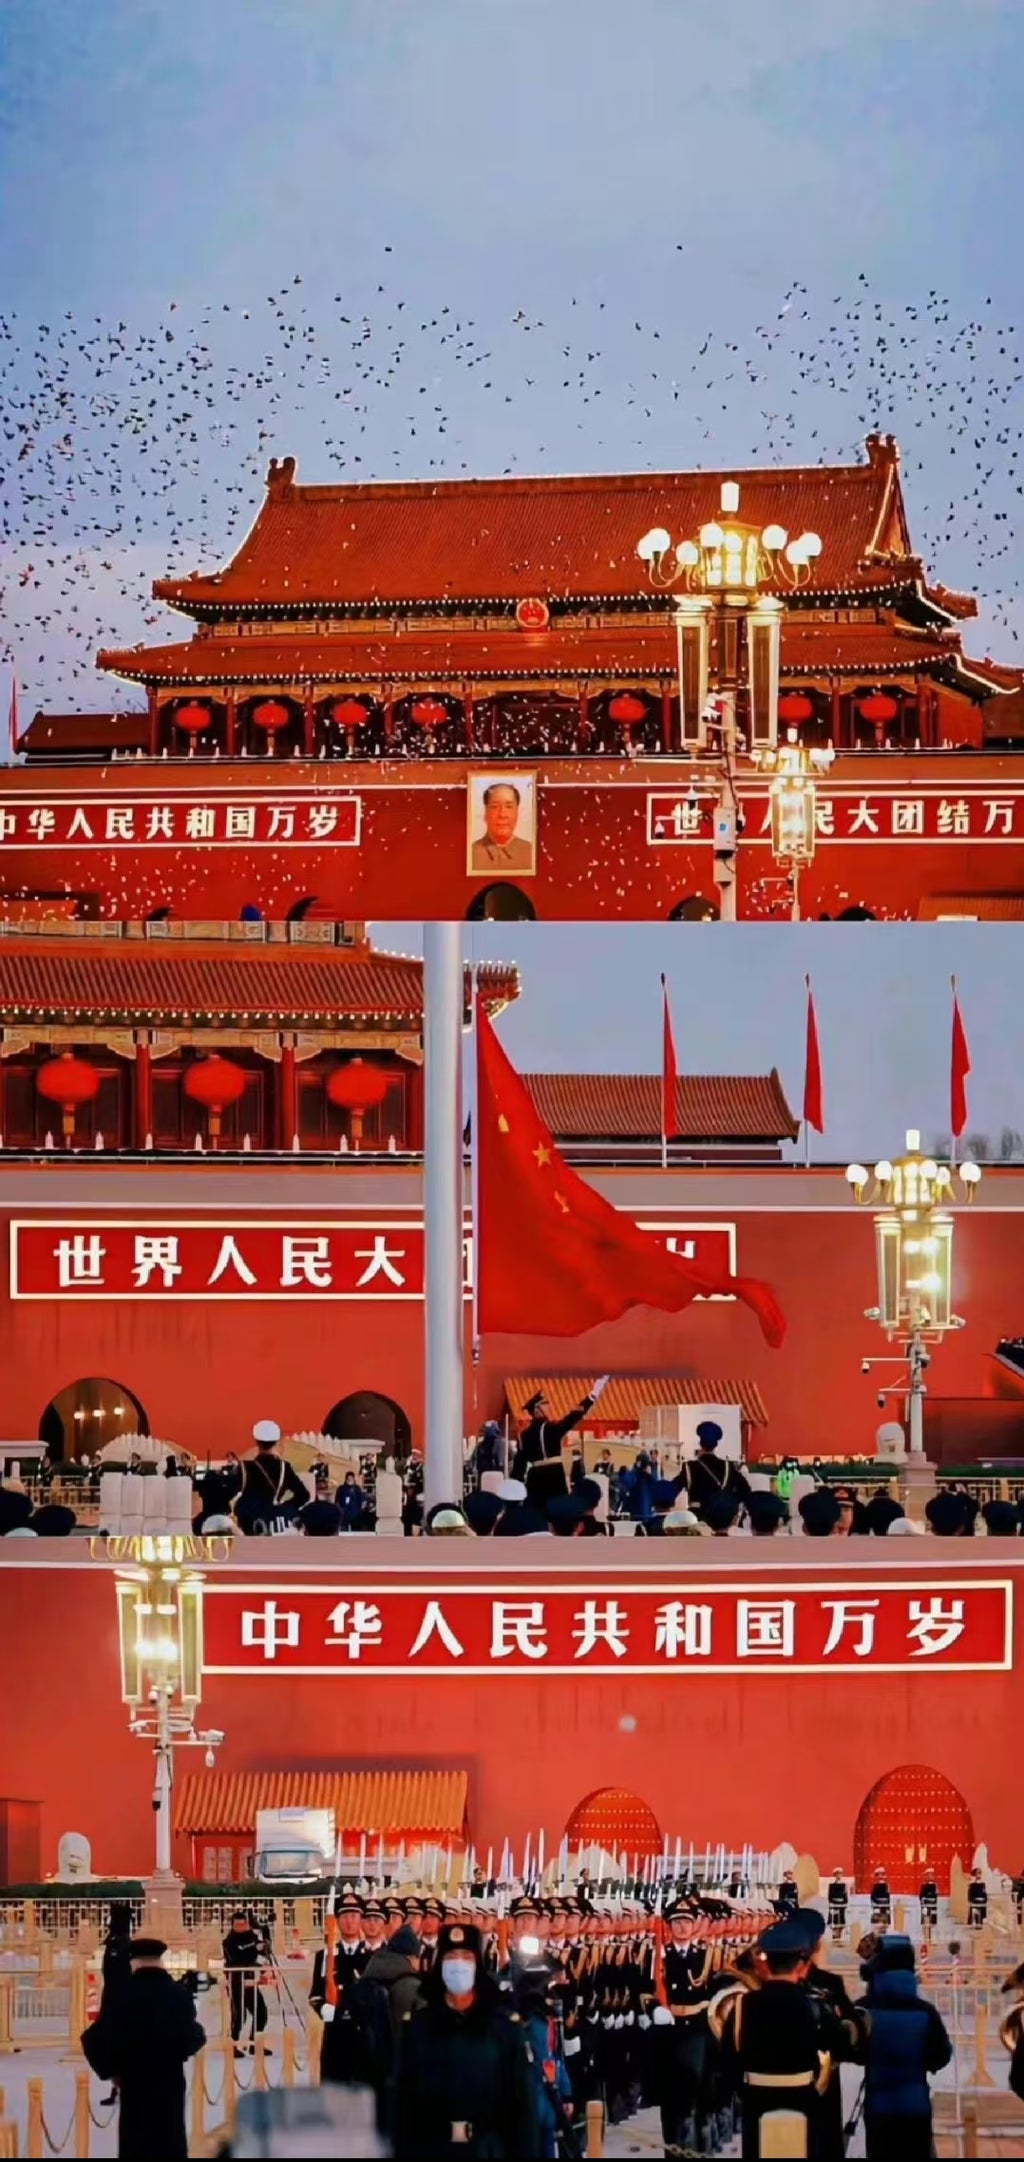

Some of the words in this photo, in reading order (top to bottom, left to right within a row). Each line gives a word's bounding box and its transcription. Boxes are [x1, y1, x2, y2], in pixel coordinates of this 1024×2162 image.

[0, 804, 338, 841] 中华人民共和国万岁
[670, 799, 1016, 835] 世民大团结万
[53, 1235, 473, 1288] 世界人民大
[241, 1597, 966, 1659] 中华人民共和国万岁
